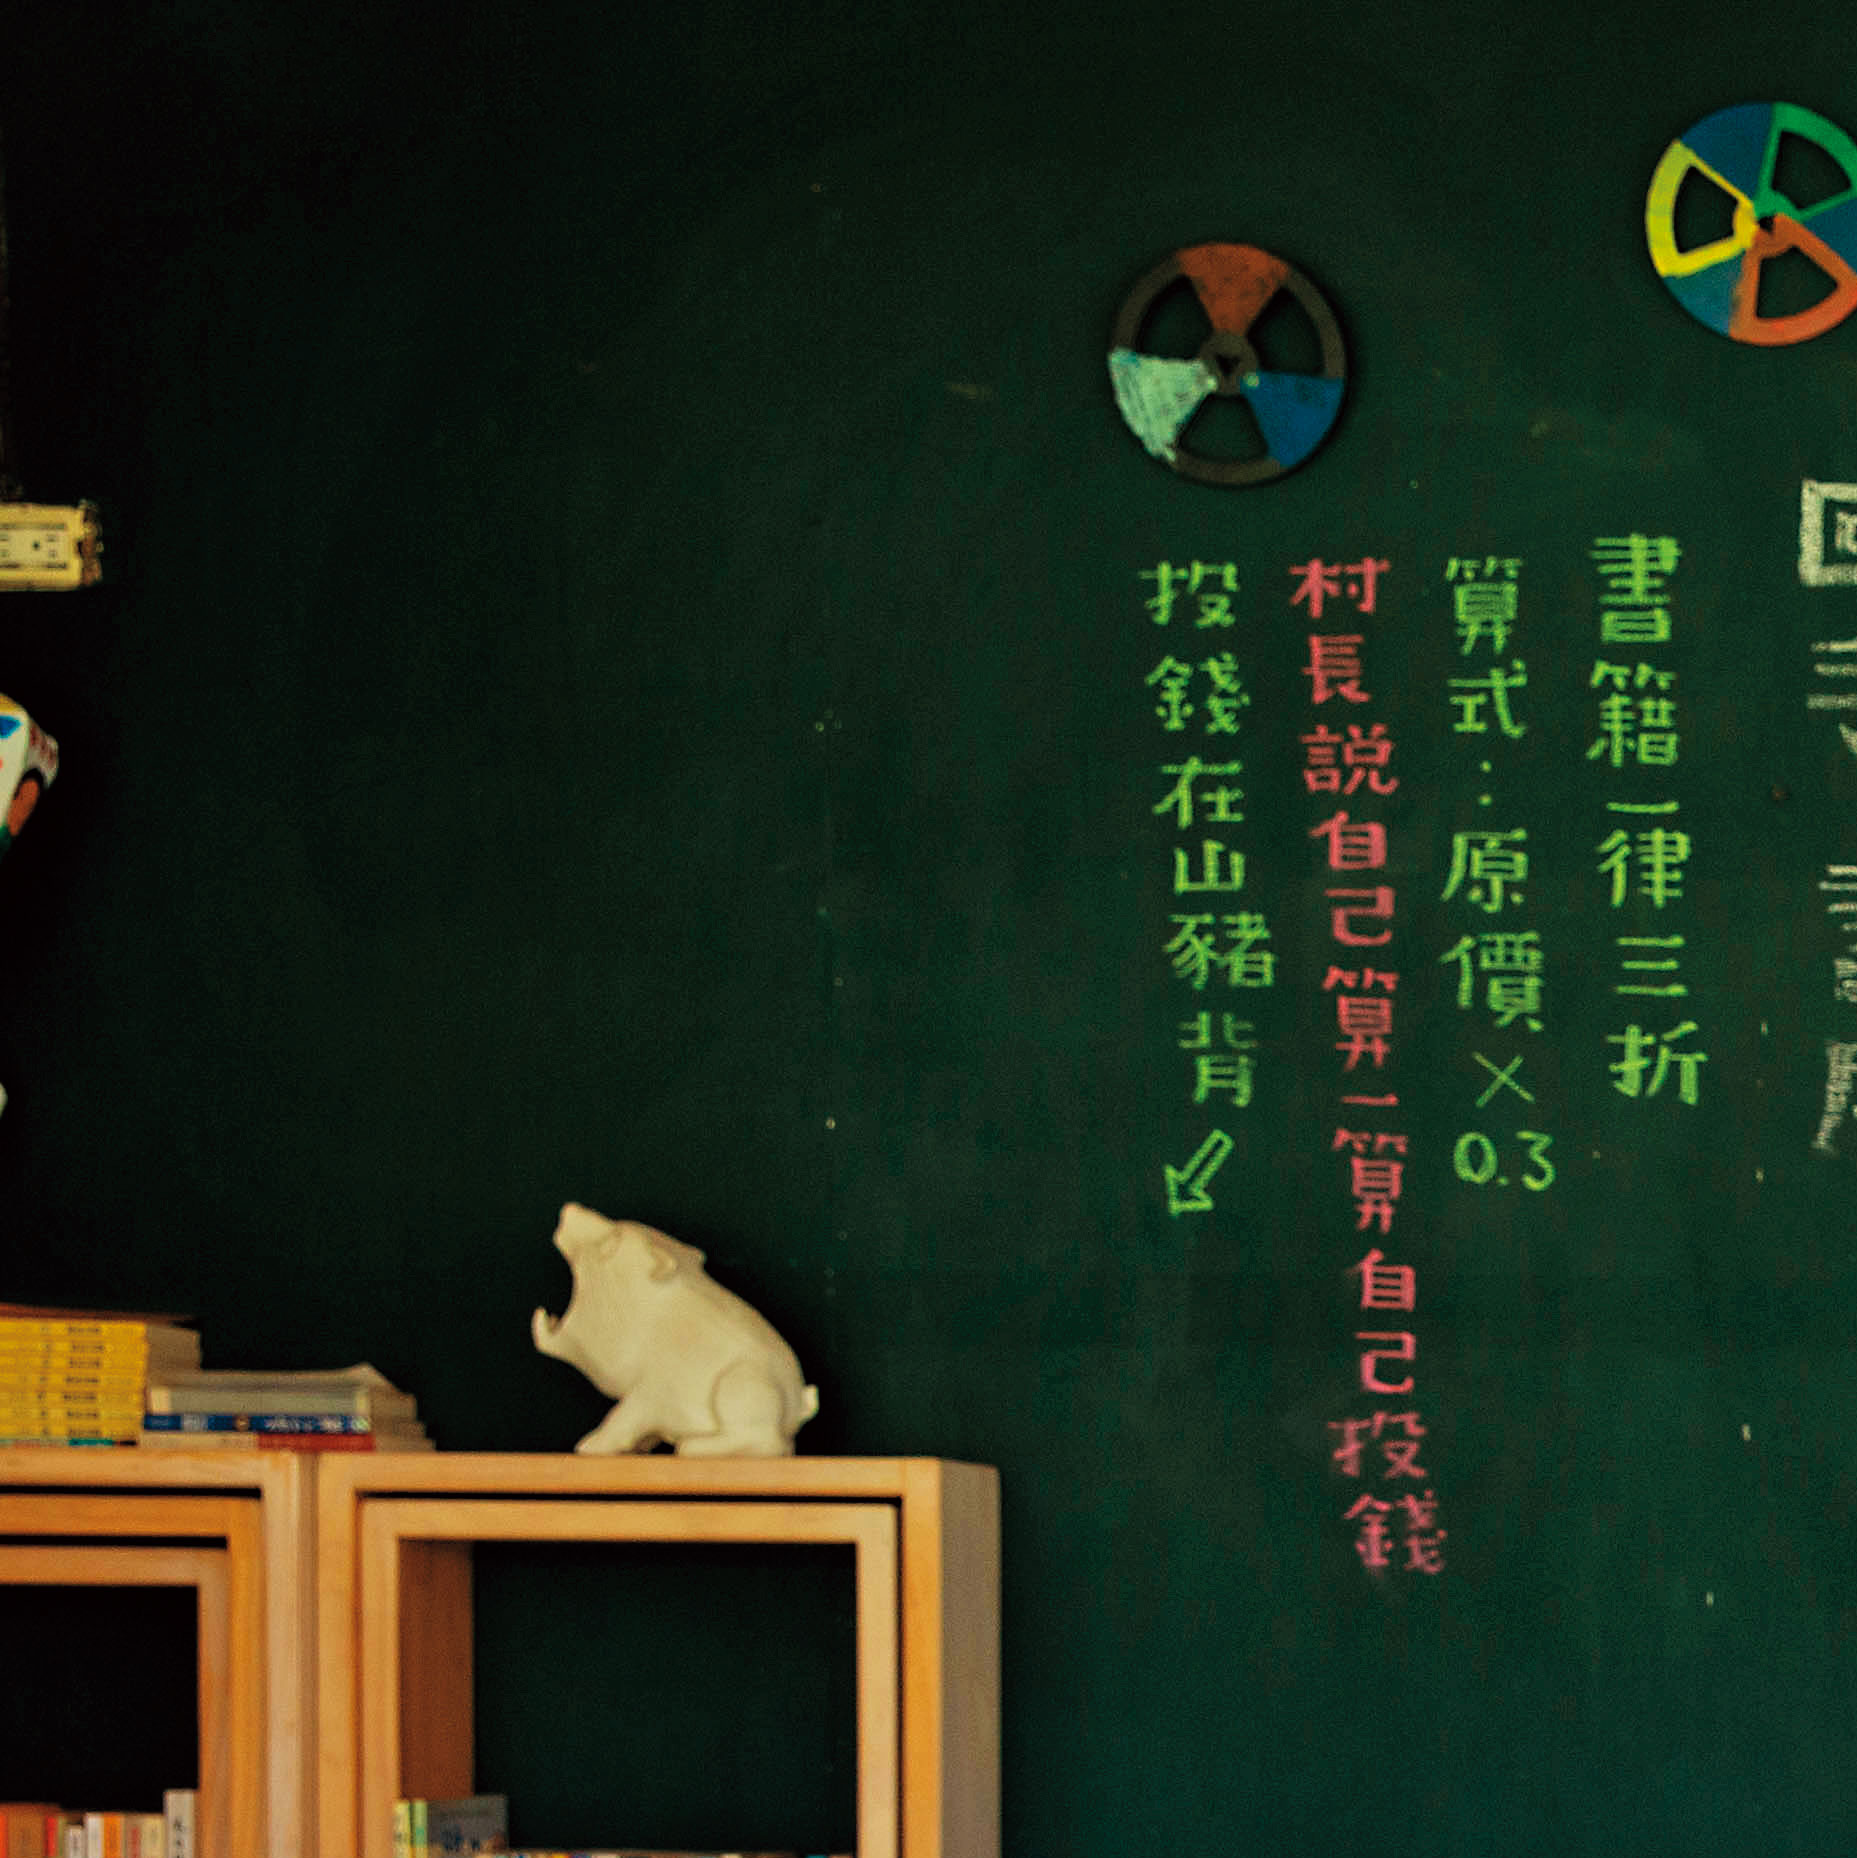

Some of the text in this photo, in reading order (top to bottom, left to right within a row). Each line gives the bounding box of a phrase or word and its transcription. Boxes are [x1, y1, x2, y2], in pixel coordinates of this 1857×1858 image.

[1141, 560, 1275, 1107] 投錢在山豬背
[1586, 533, 1708, 1105] 書籍一律三折
